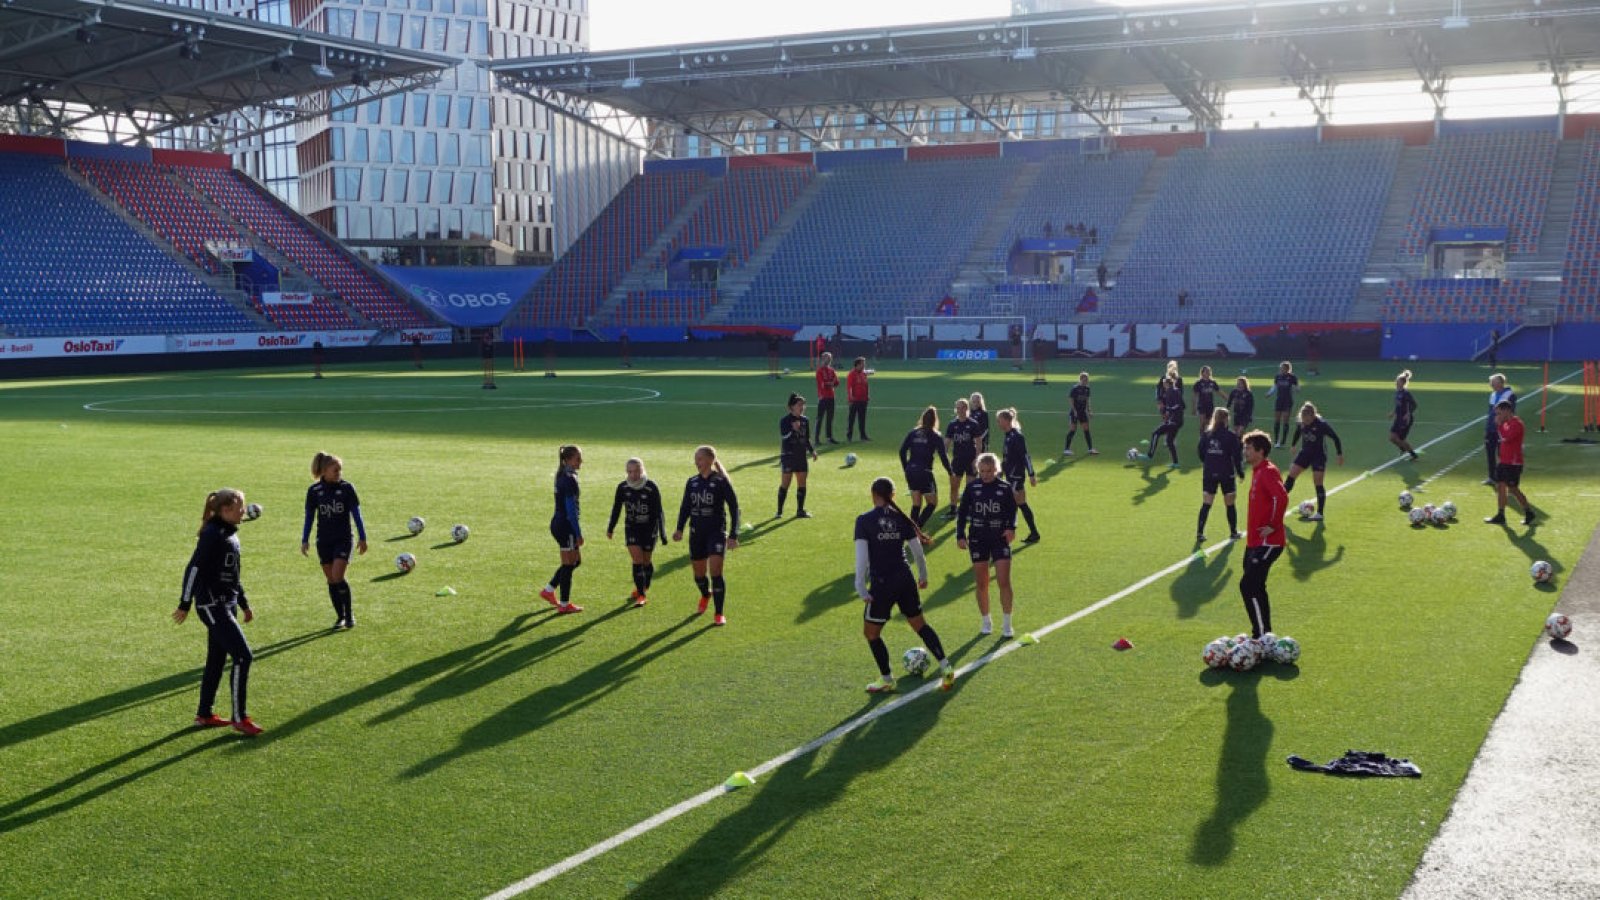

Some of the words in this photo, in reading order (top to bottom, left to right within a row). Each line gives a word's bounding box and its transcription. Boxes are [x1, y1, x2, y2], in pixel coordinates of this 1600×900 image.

[448, 292, 511, 308] OBOS
[63, 340, 115, 353] OsloTaxi
[258, 335, 299, 347] OsloTaxi
[957, 350, 989, 360] OBOS
[319, 500, 345, 518] DNB
[975, 499, 1001, 515] DNB
